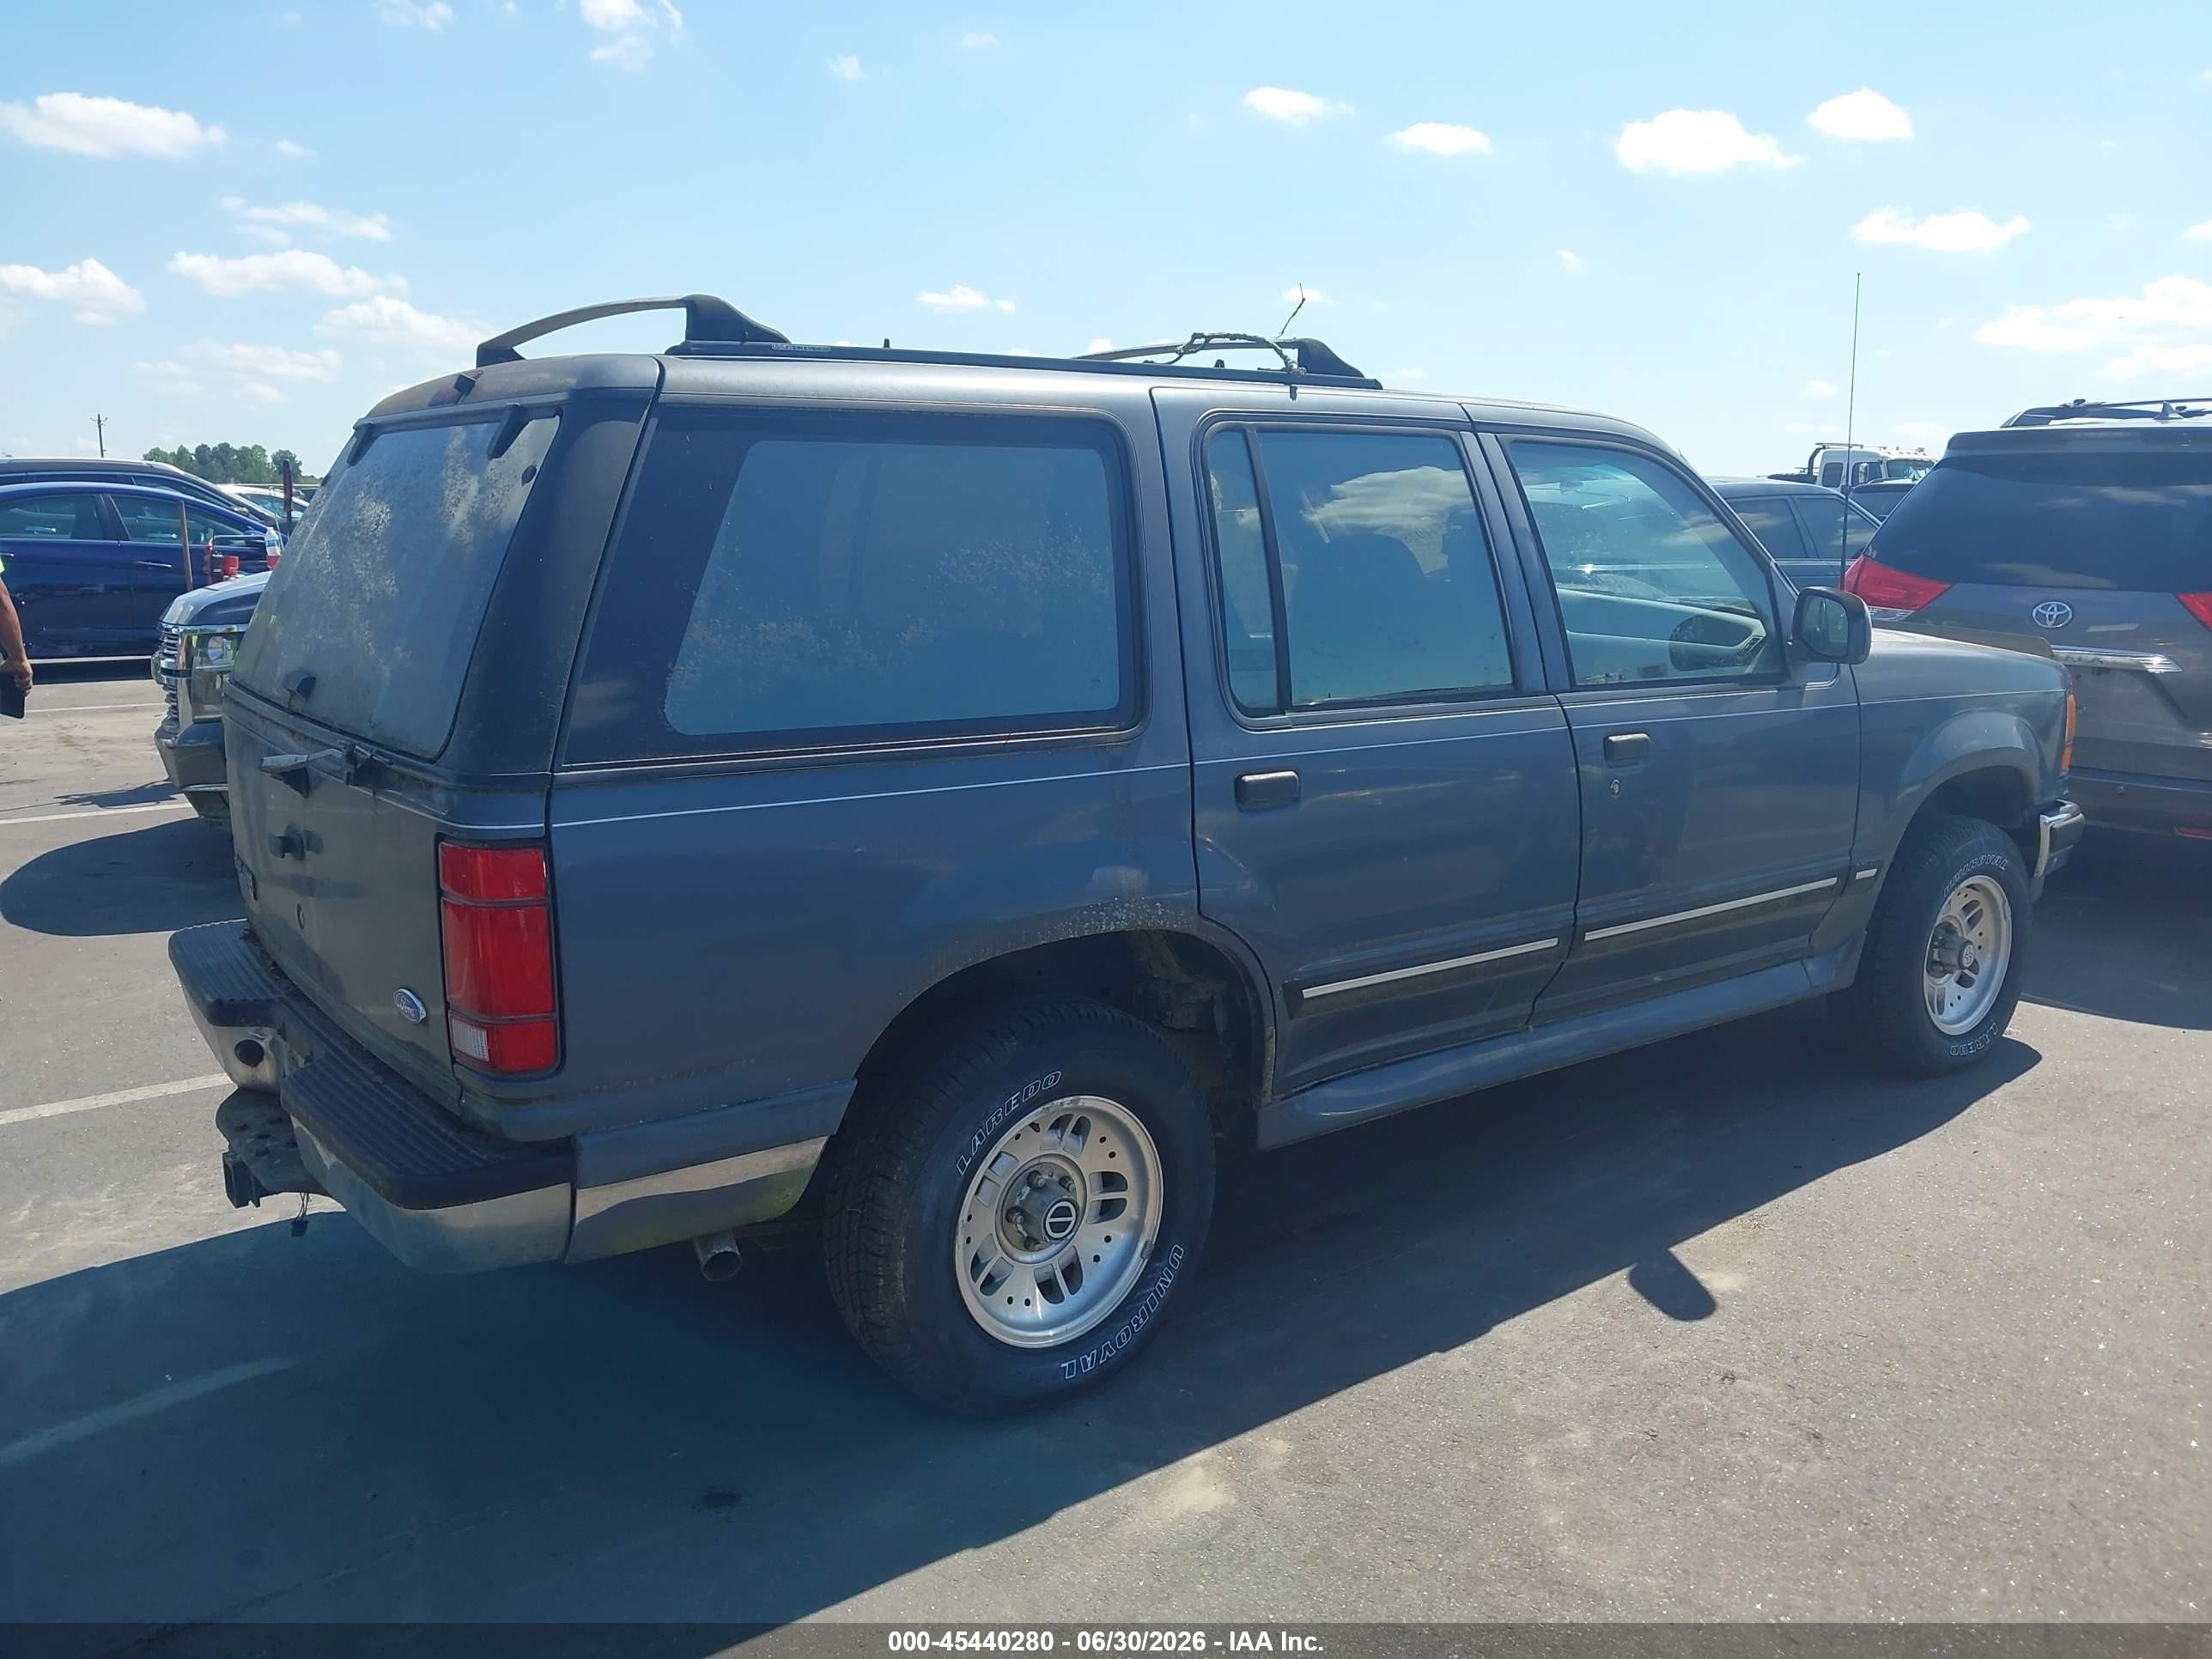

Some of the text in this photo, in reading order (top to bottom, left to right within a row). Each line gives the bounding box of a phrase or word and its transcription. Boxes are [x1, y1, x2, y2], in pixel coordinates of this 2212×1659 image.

[1949, 1022, 1999, 1056] LAREDO
[956, 1070, 1062, 1176] LAREDO
[1060, 1244, 1184, 1380] UNIROYAL
